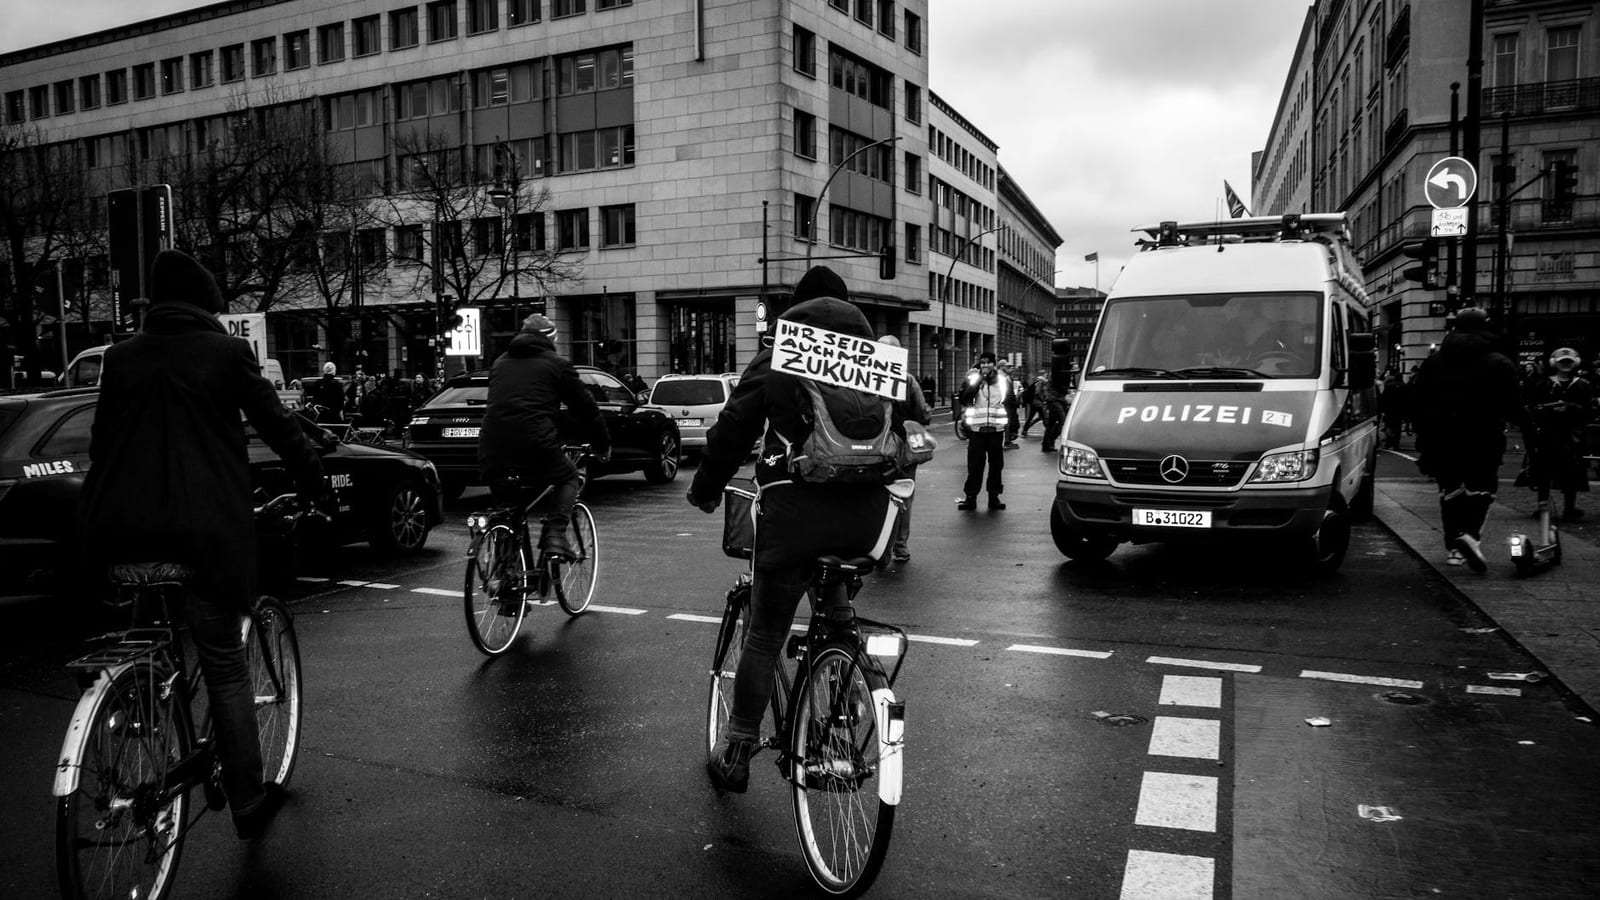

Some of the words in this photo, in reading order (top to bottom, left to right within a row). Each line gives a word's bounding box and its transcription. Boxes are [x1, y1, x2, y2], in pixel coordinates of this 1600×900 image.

[229, 320, 250, 337] DIE
[781, 323, 818, 344] IHR
[823, 332, 876, 355] SEID
[780, 338, 835, 358] AUCH
[837, 350, 903, 376] MEINE
[779, 348, 907, 398] ZUKUNFT
[1117, 404, 1252, 425] POLIZEI
[23, 460, 74, 479] MILES
